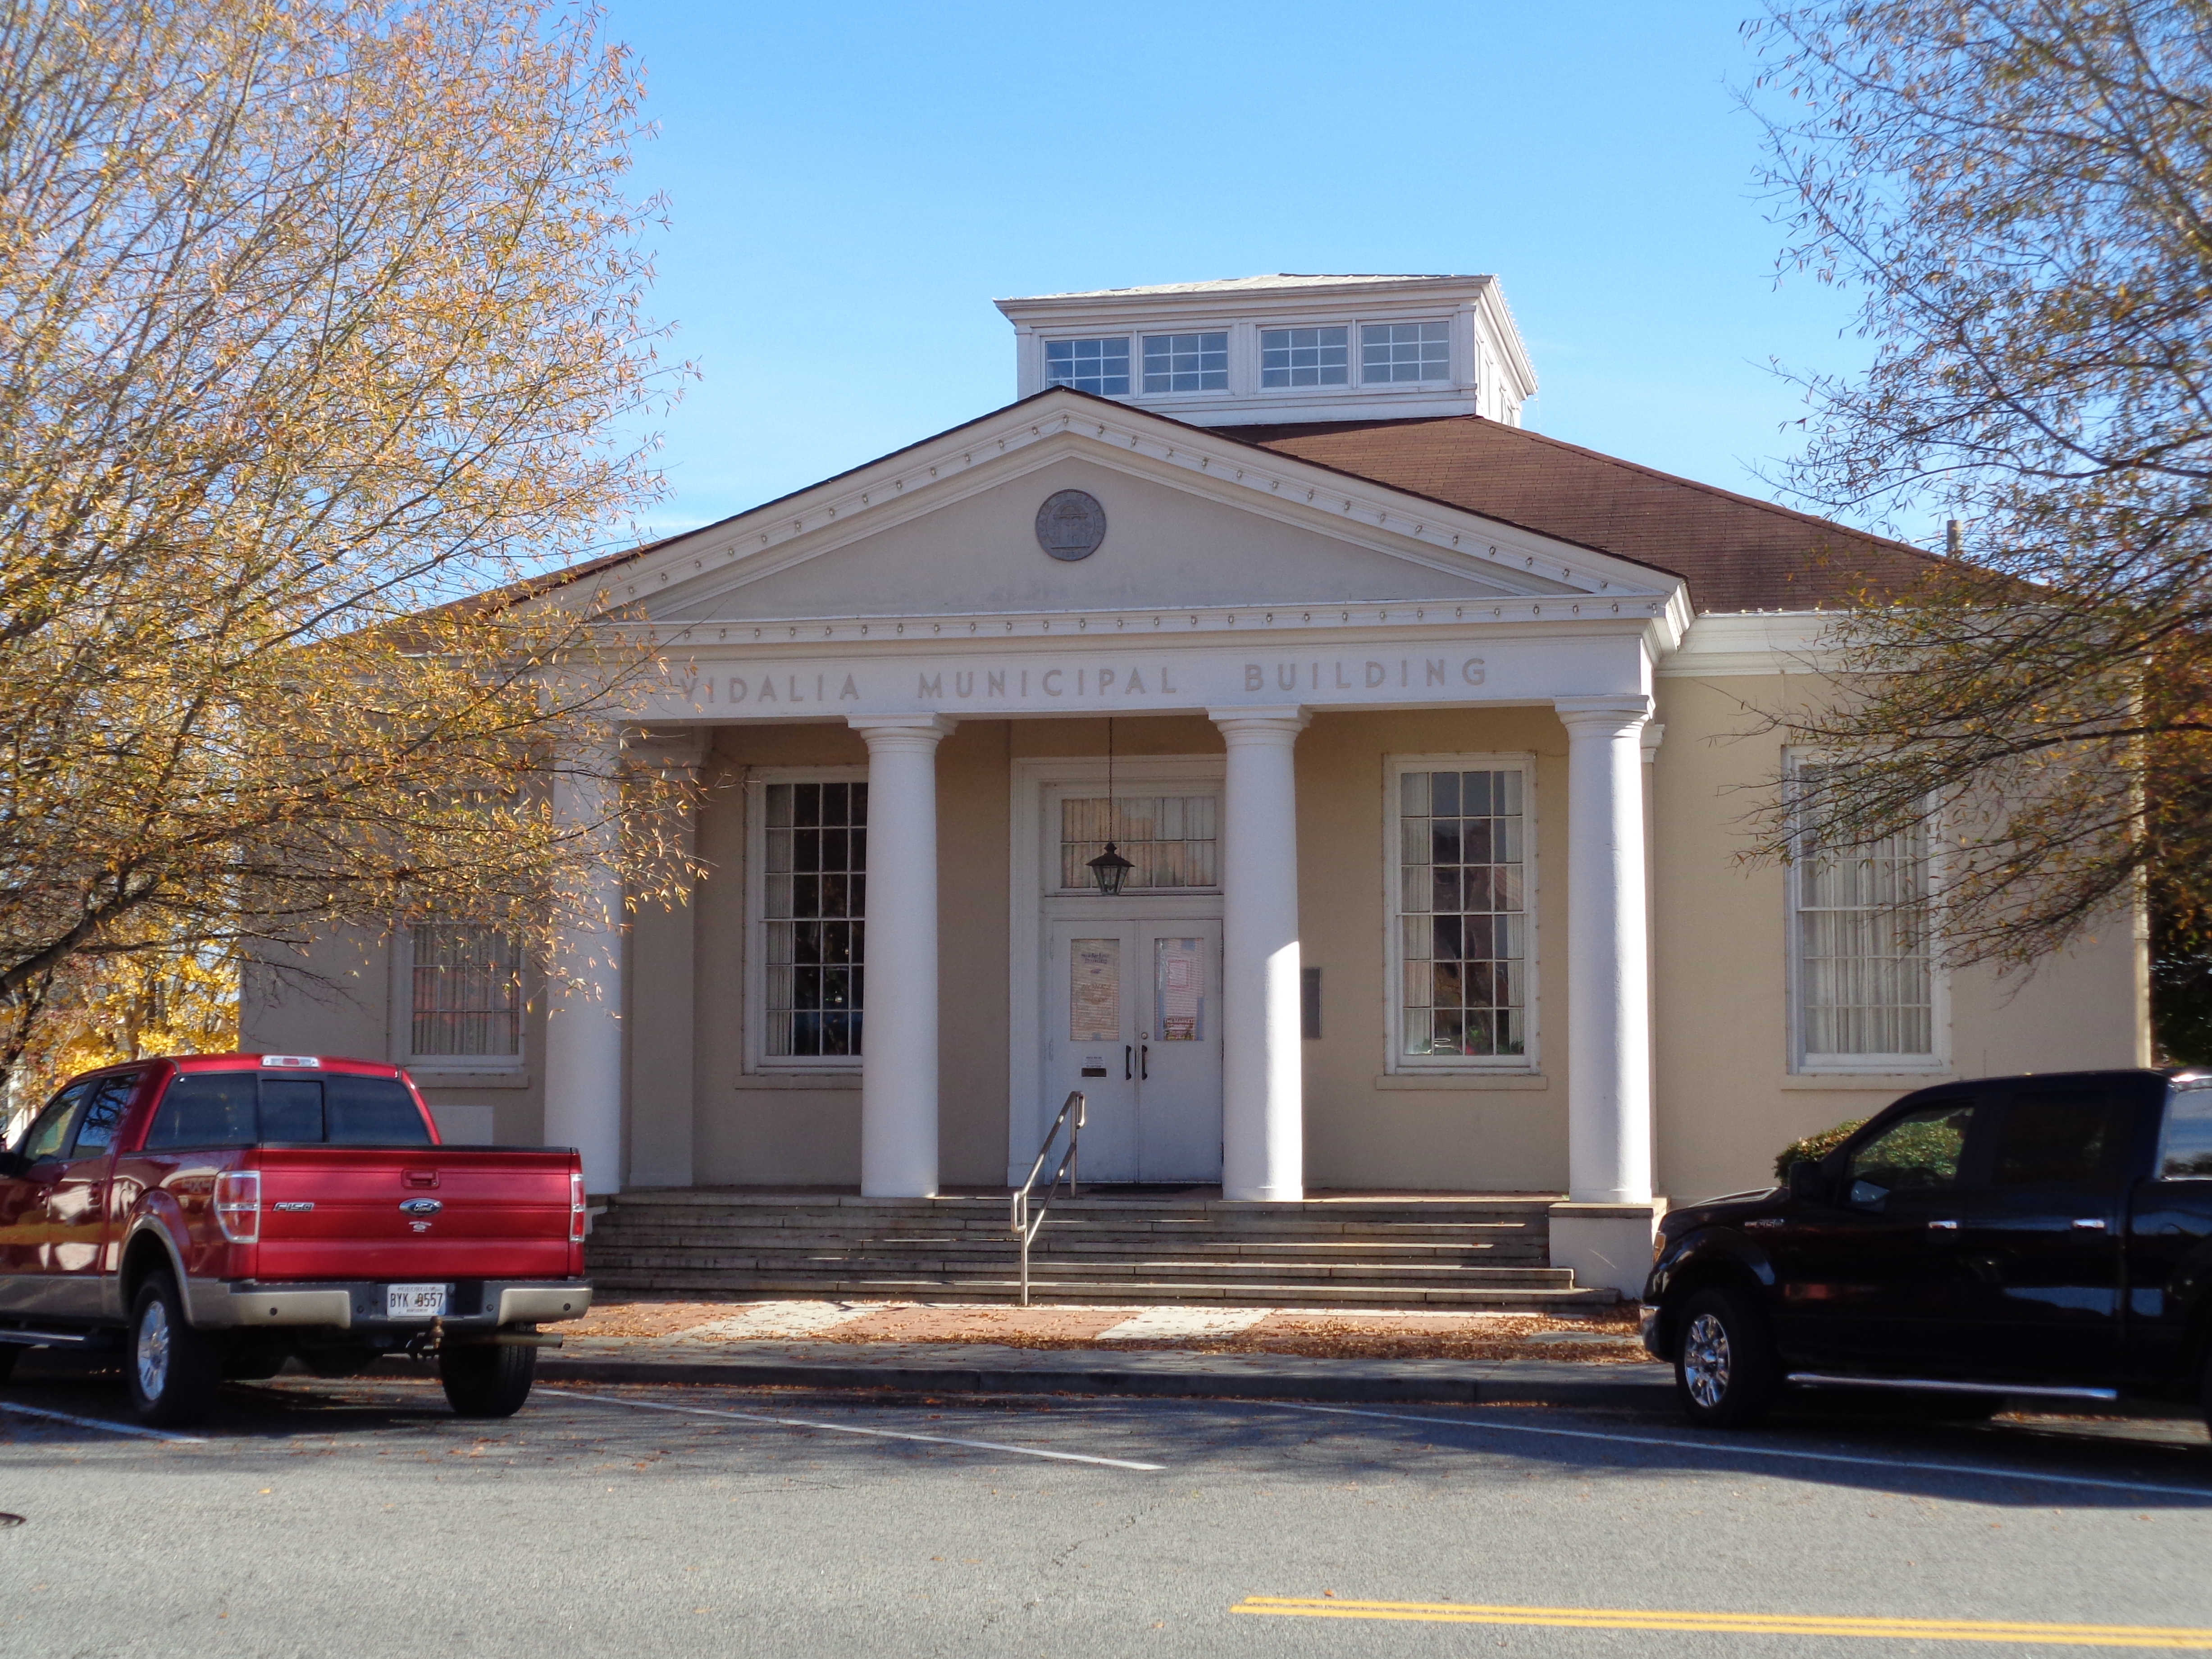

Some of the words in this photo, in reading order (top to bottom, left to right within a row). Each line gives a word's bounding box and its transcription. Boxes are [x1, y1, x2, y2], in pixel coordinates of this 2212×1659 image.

[680, 673, 860, 703] VIDALIA
[917, 666, 1177, 699] MUNICIPAL
[1244, 657, 1486, 691] BUILDING
[414, 1203, 433, 1212] Ford
[390, 1293, 409, 1308] BYK
